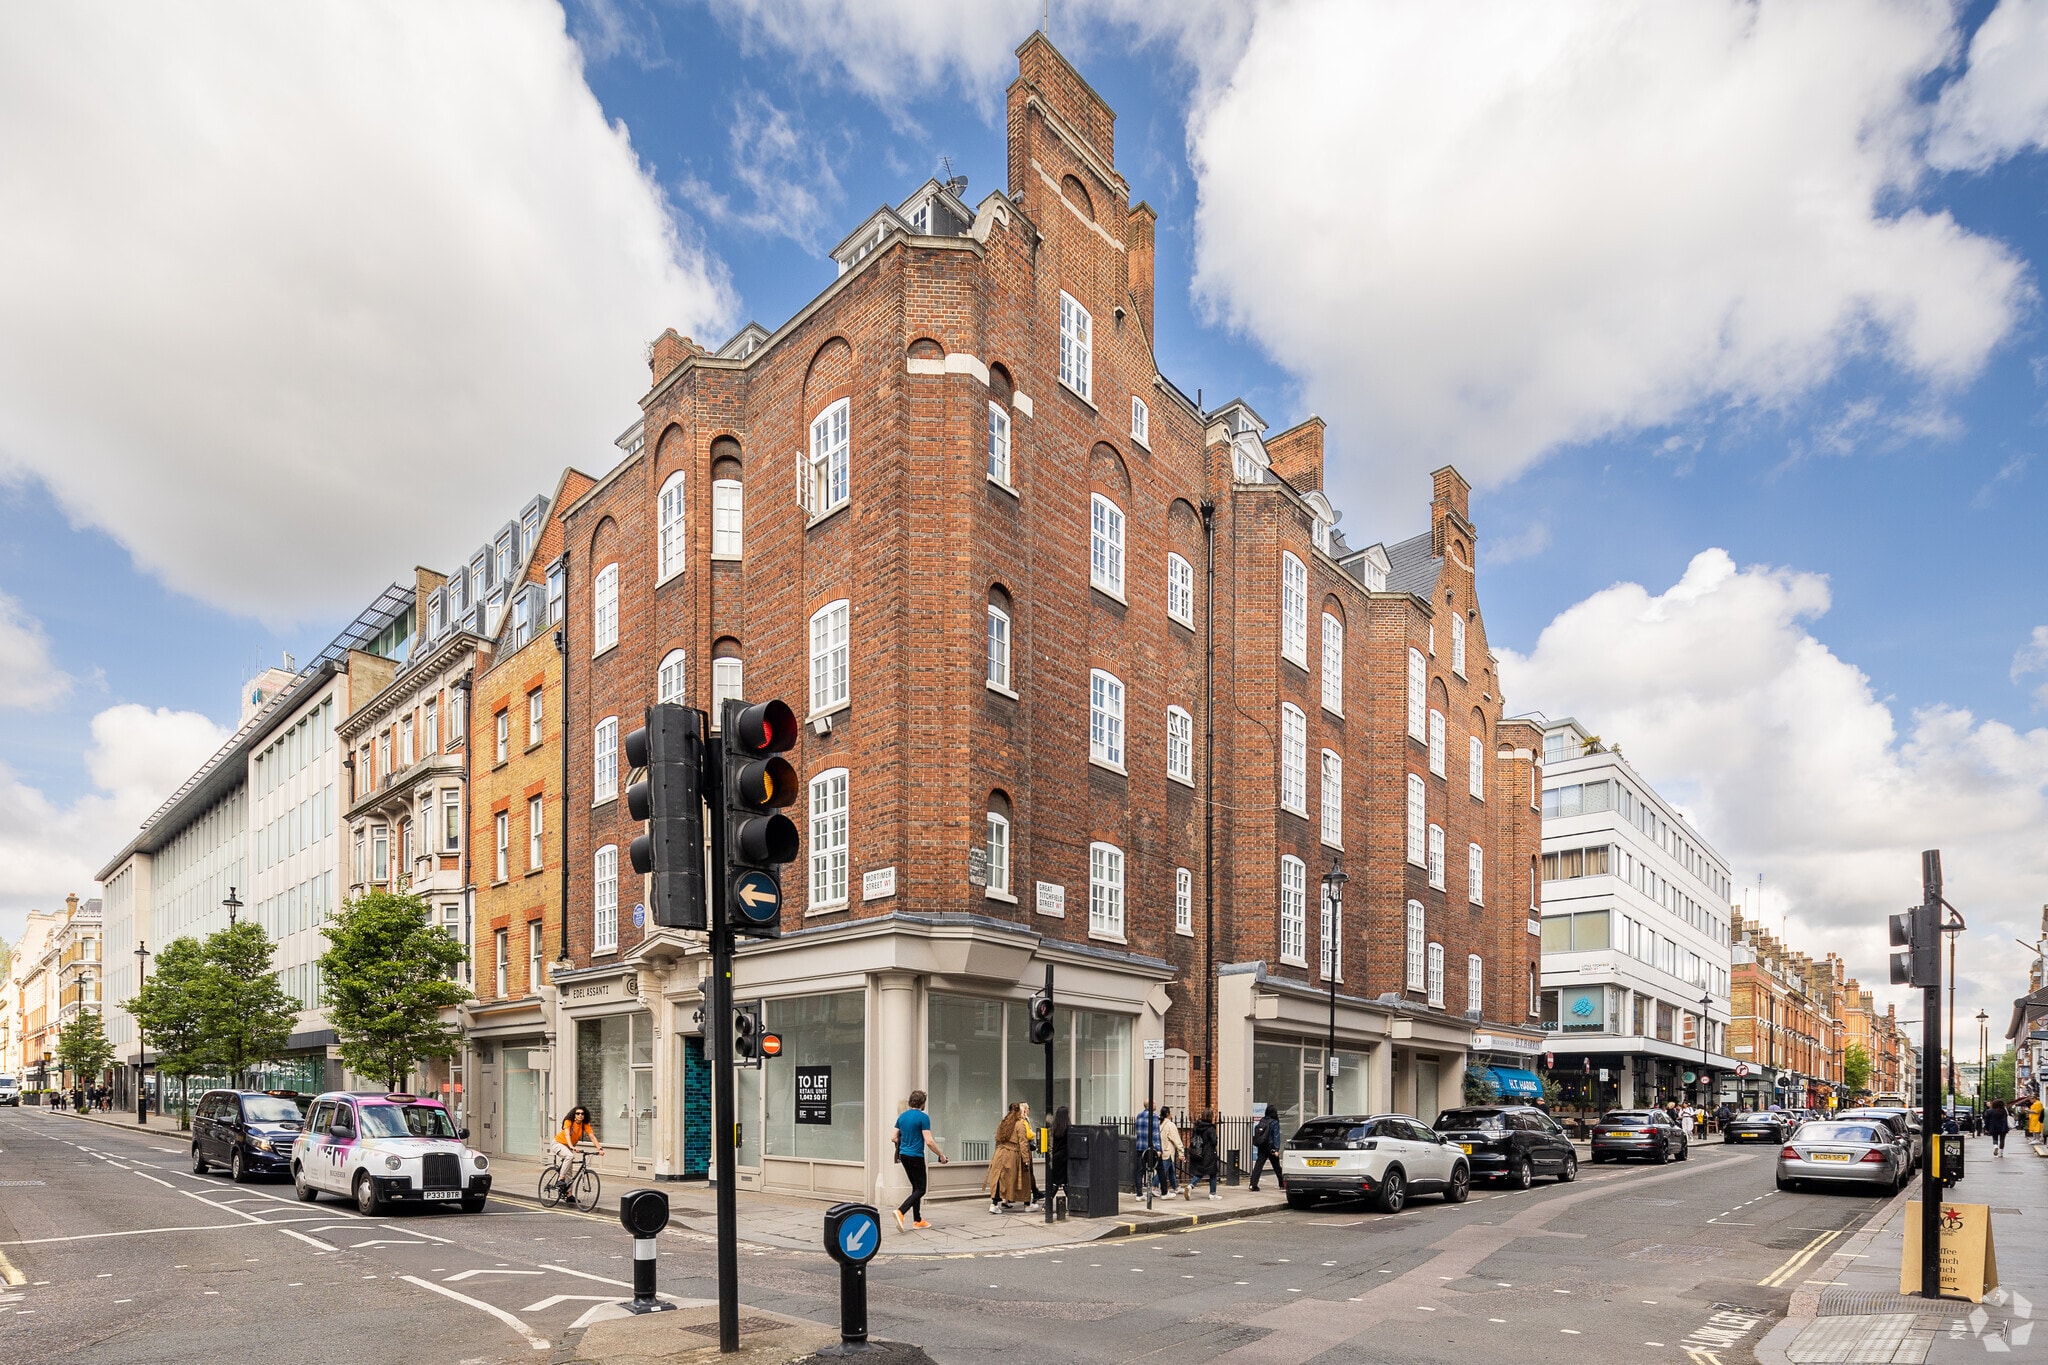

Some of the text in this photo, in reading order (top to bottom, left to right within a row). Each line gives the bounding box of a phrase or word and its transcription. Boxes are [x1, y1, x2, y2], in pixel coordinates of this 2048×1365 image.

[866, 870, 892, 882] MORTIMER
[866, 880, 882, 891] STREET
[1039, 884, 1053, 893] GREAT
[1039, 892, 1063, 903] TITCHFIELD
[1039, 899, 1055, 908] STREET
[573, 985, 609, 999] EDEL ASSANTI
[798, 1075, 829, 1088] TO LET
[426, 1191, 459, 1199] P333 BTR
